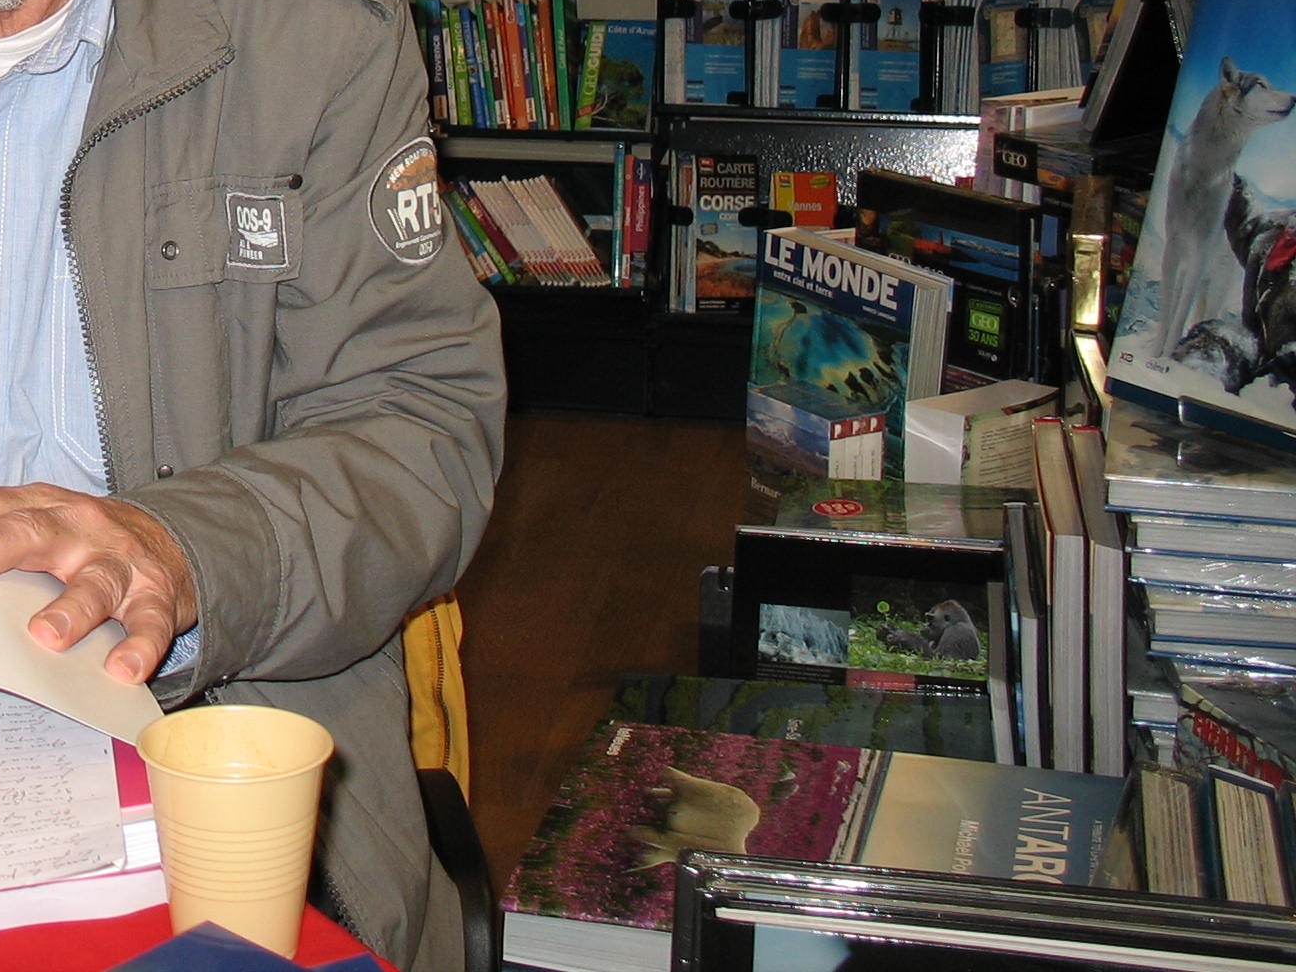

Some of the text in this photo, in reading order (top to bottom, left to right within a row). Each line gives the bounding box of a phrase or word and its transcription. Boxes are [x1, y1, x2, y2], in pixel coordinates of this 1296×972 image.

[434, 35, 443, 83] Provence
[1002, 149, 1027, 168] GEO
[717, 162, 755, 176] CARTE
[700, 174, 756, 189] ROUTIÈRE
[635, 185, 645, 232] Philippines
[699, 194, 755, 212] CORSE
[764, 235, 900, 311] LE MONDE
[968, 328, 1000, 348] 30 ANS
